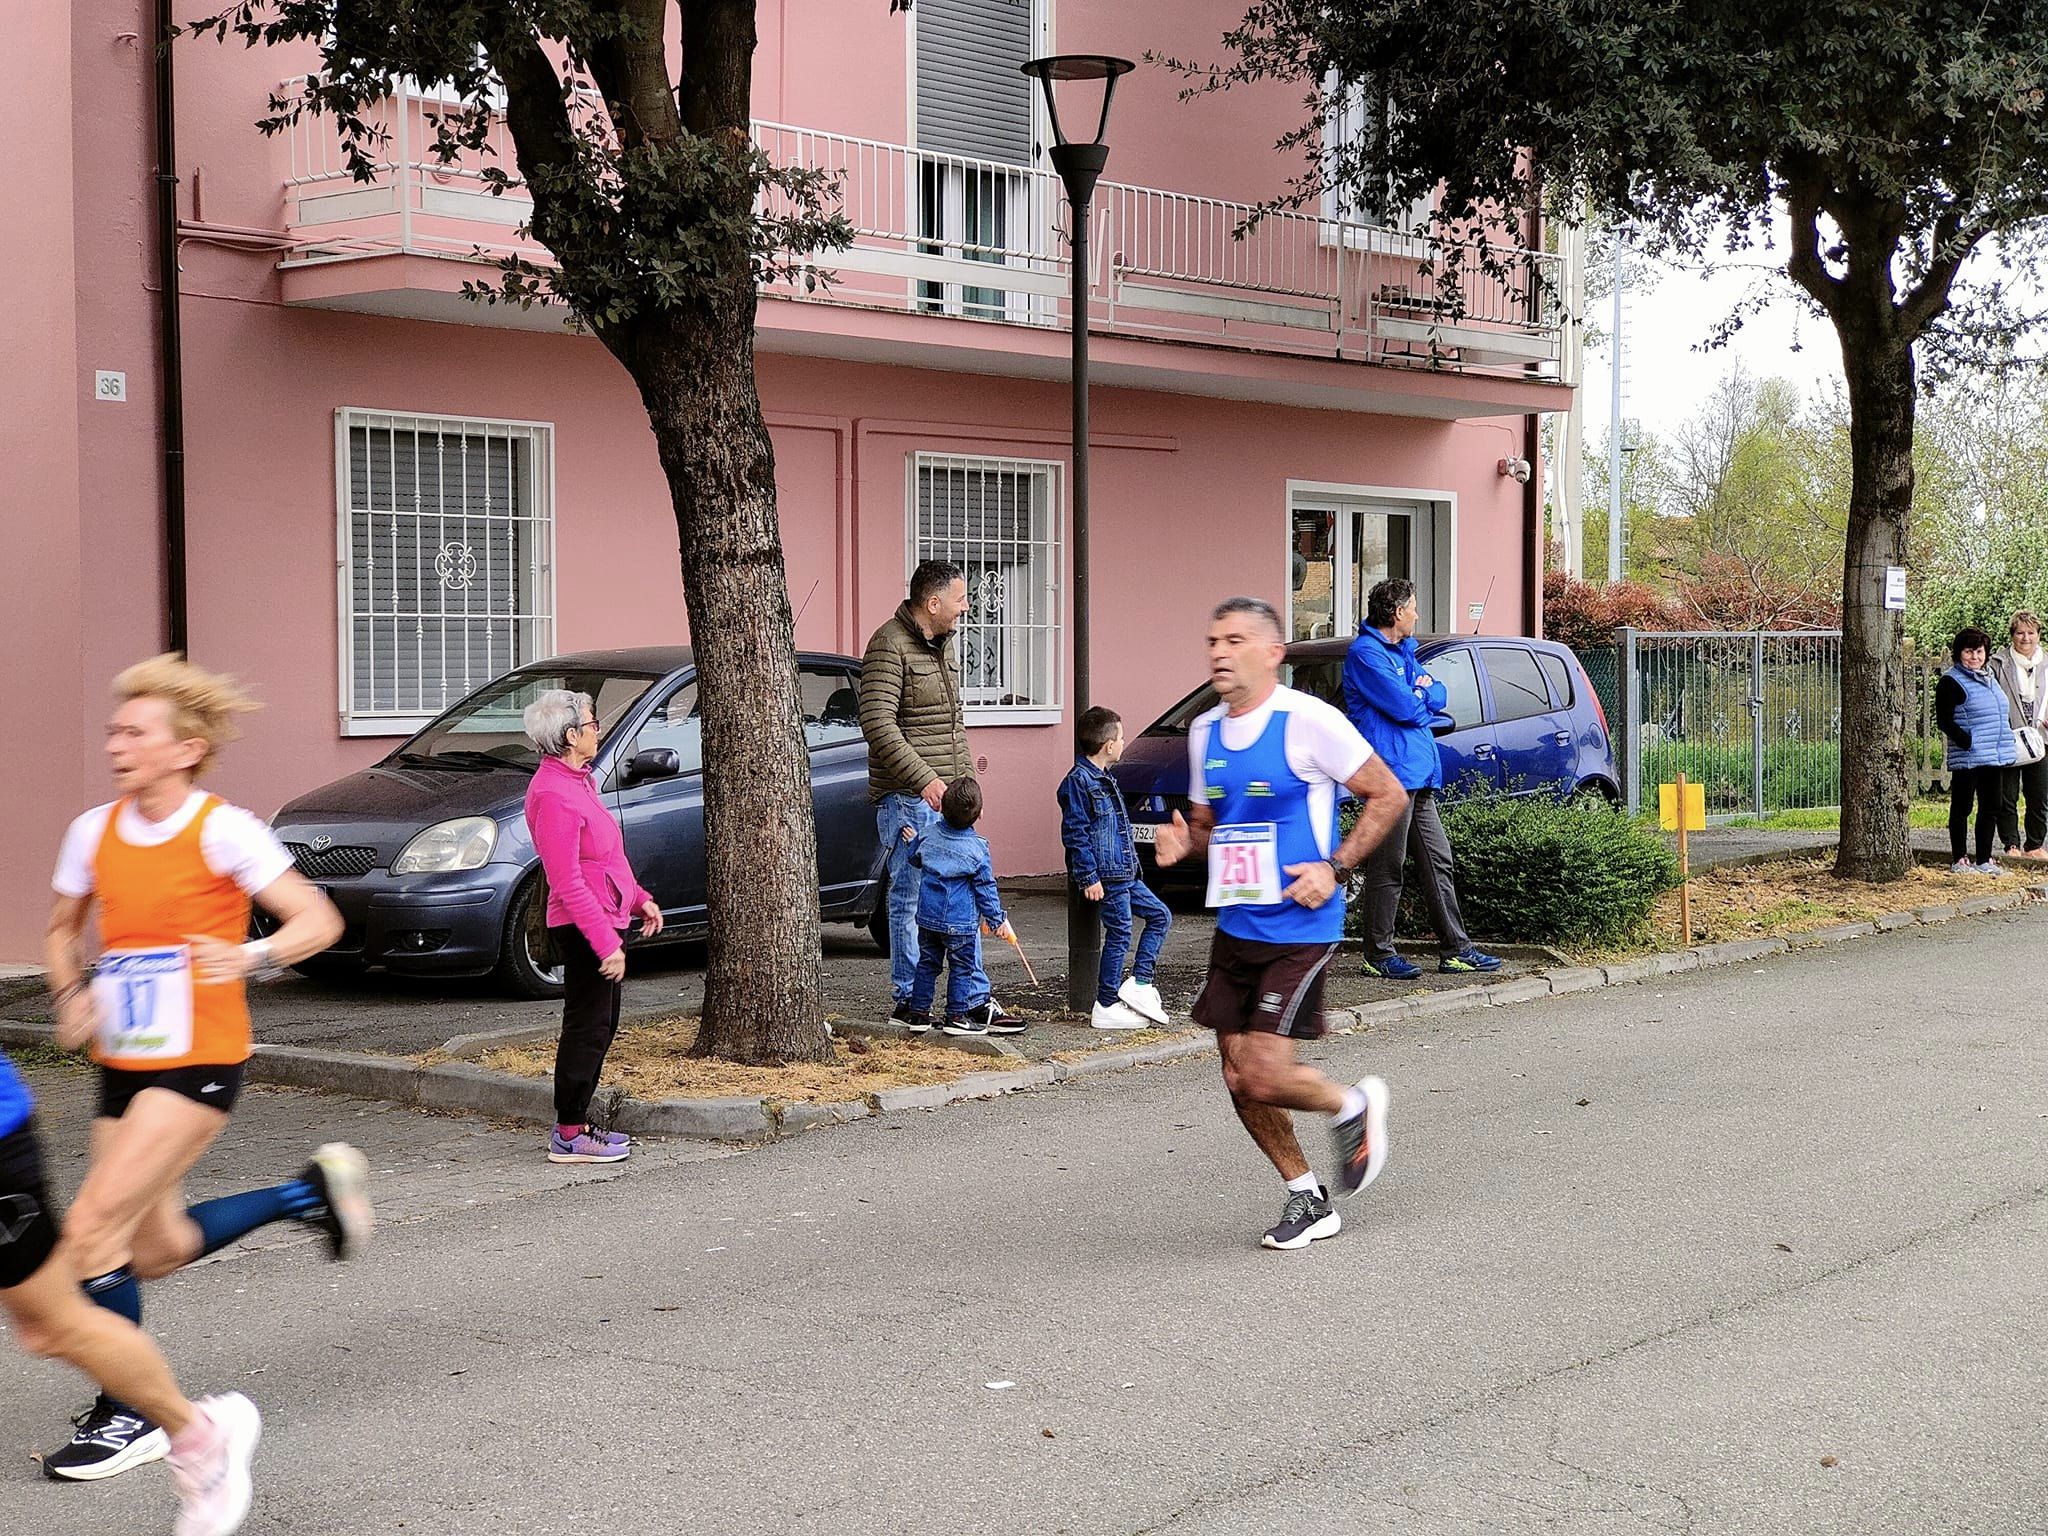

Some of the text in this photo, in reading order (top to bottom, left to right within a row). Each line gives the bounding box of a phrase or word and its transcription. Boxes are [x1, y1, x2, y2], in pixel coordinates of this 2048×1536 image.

[101, 378, 120, 395] 36
[1133, 826, 1158, 840] 752J
[1220, 846, 1260, 885] 251
